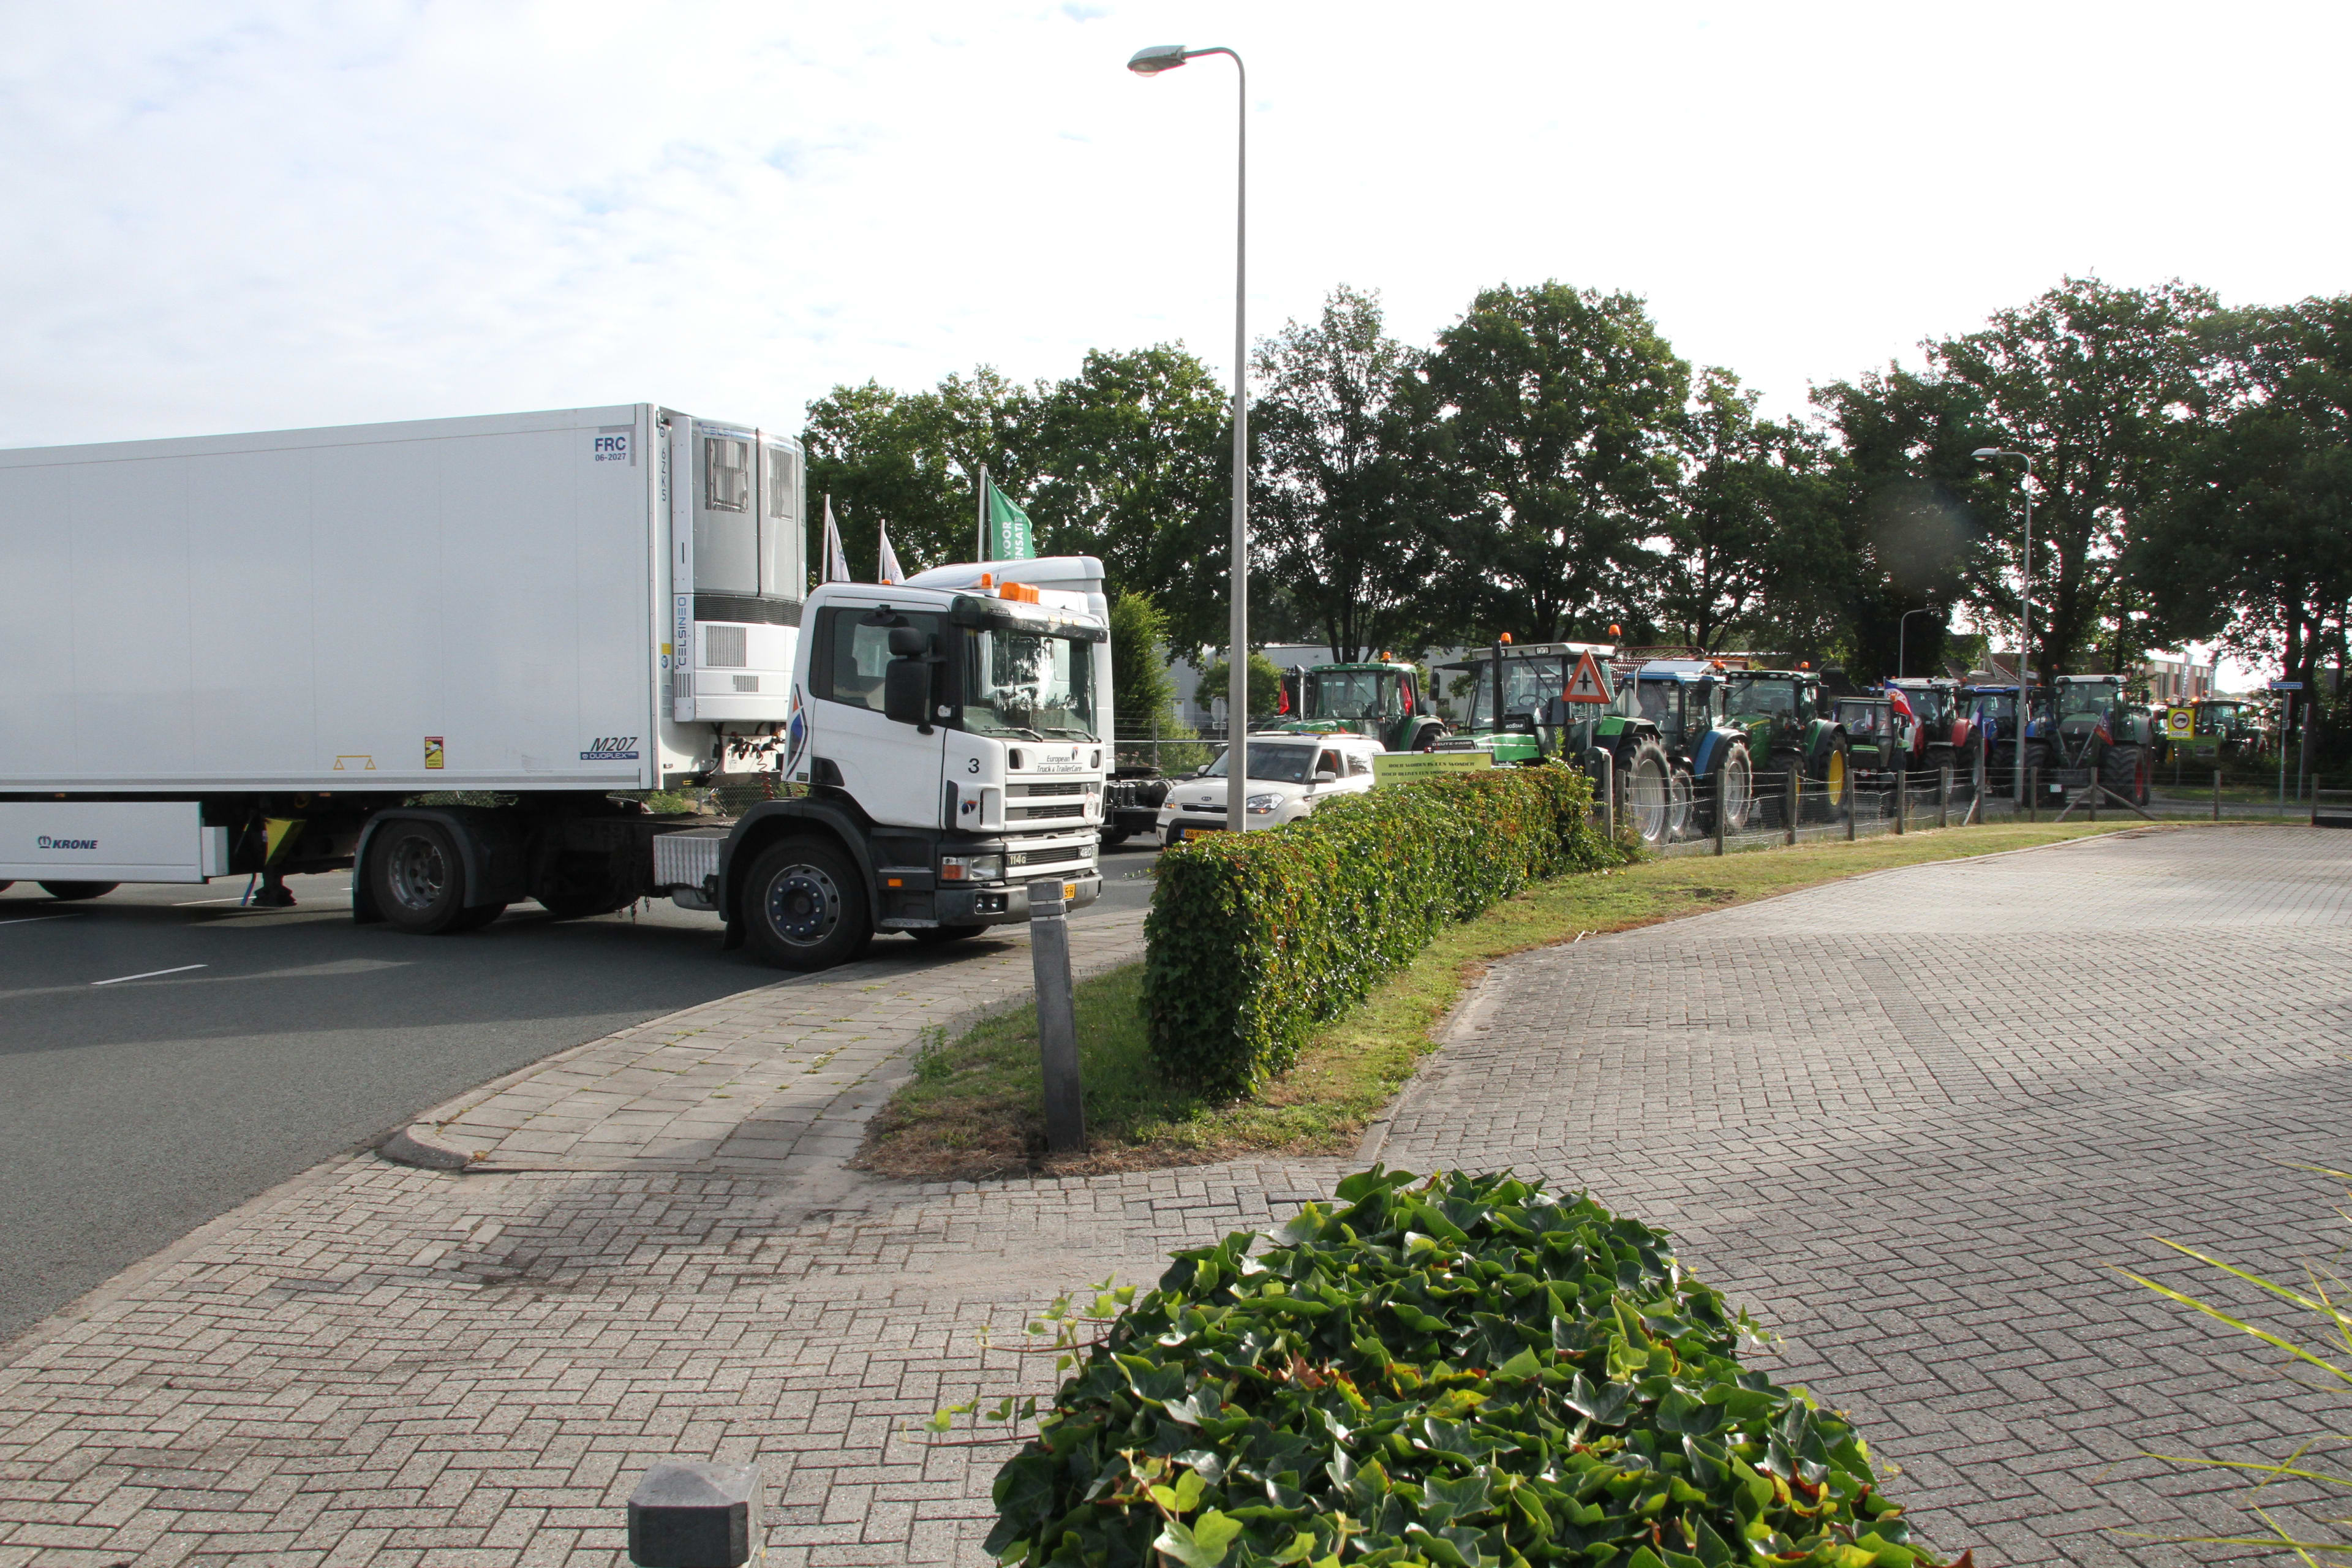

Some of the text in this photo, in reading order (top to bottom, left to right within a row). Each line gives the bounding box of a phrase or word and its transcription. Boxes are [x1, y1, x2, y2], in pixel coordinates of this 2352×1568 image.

[595, 437, 626, 451] FRC
[1002, 522, 1011, 557] VOOR
[590, 737, 638, 752] M207
[1047, 755, 1070, 764] European
[968, 758, 980, 774] 3
[53, 840, 98, 849] KRONE
[1009, 855, 1026, 864] 114G
[1064, 886, 1074, 897] 5-H
